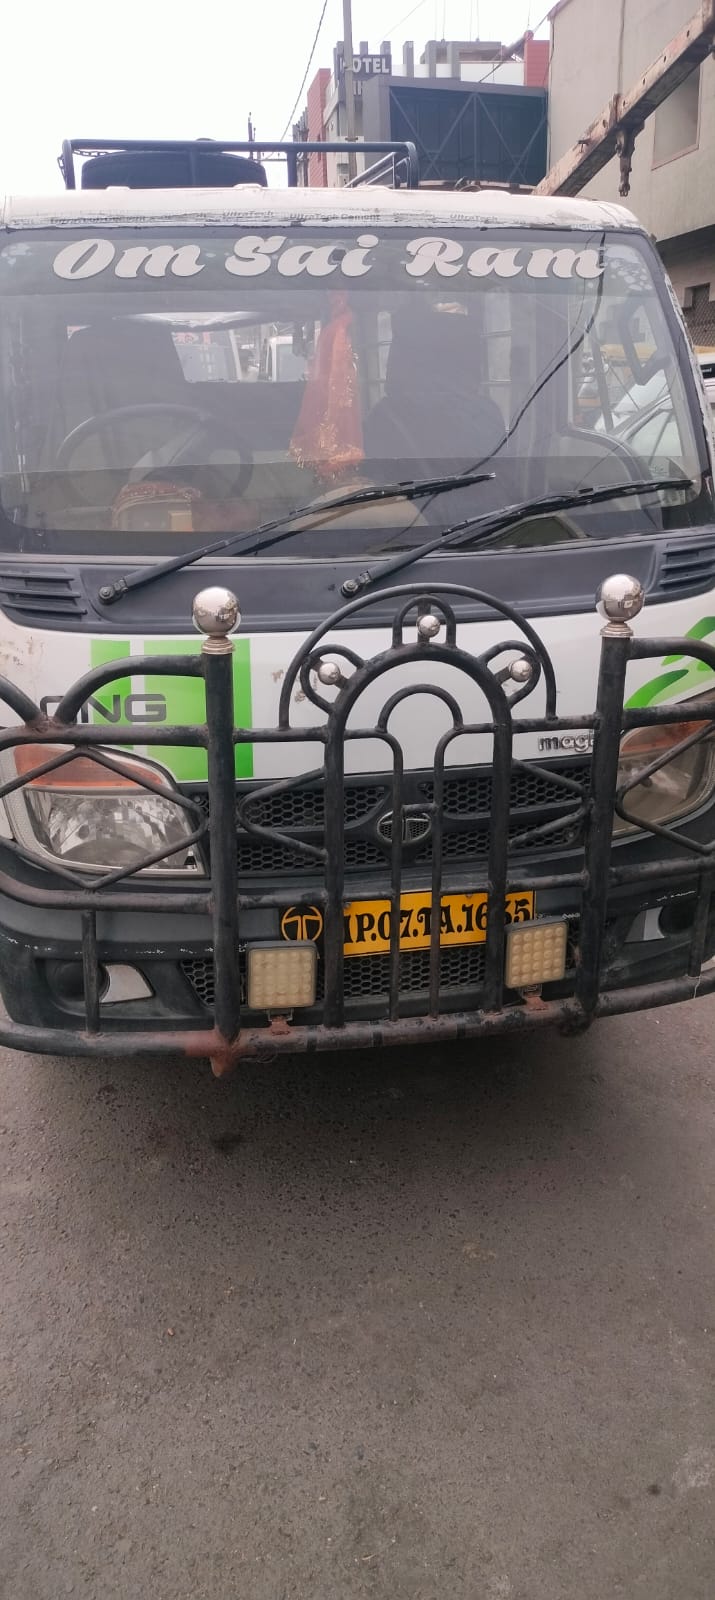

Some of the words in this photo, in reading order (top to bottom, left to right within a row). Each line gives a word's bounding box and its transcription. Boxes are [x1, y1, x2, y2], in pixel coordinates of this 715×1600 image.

[53, 238, 206, 280] Om
[224, 234, 379, 278] Sai
[404, 236, 607, 280] Ram
